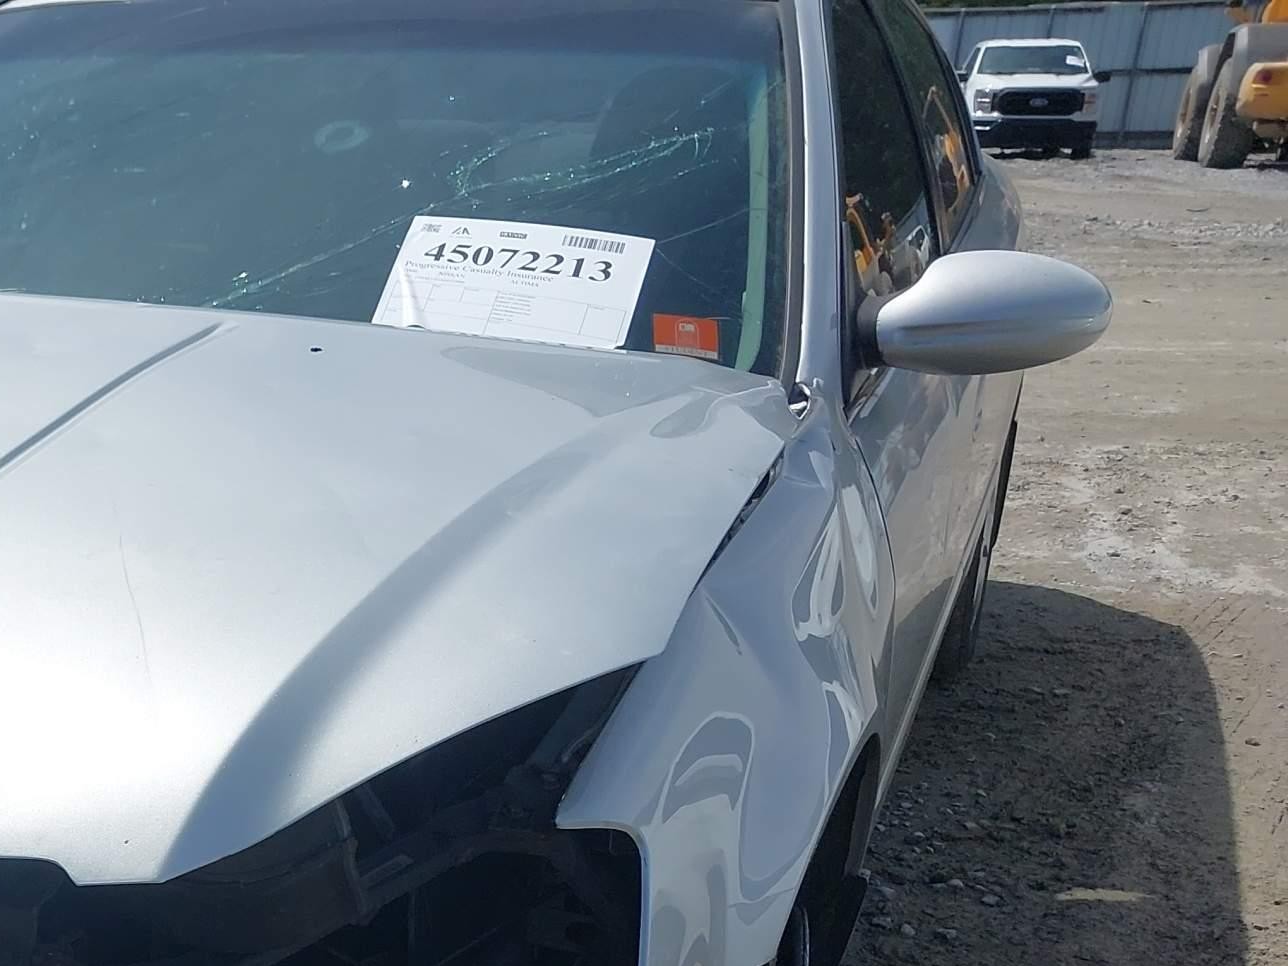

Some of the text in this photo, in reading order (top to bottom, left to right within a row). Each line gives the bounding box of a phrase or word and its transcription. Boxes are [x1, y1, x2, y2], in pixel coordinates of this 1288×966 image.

[405, 260, 460, 271] Progressive
[462, 265, 504, 277] Casualty
[506, 269, 555, 282] Insurance
[423, 242, 612, 282] 45072213
